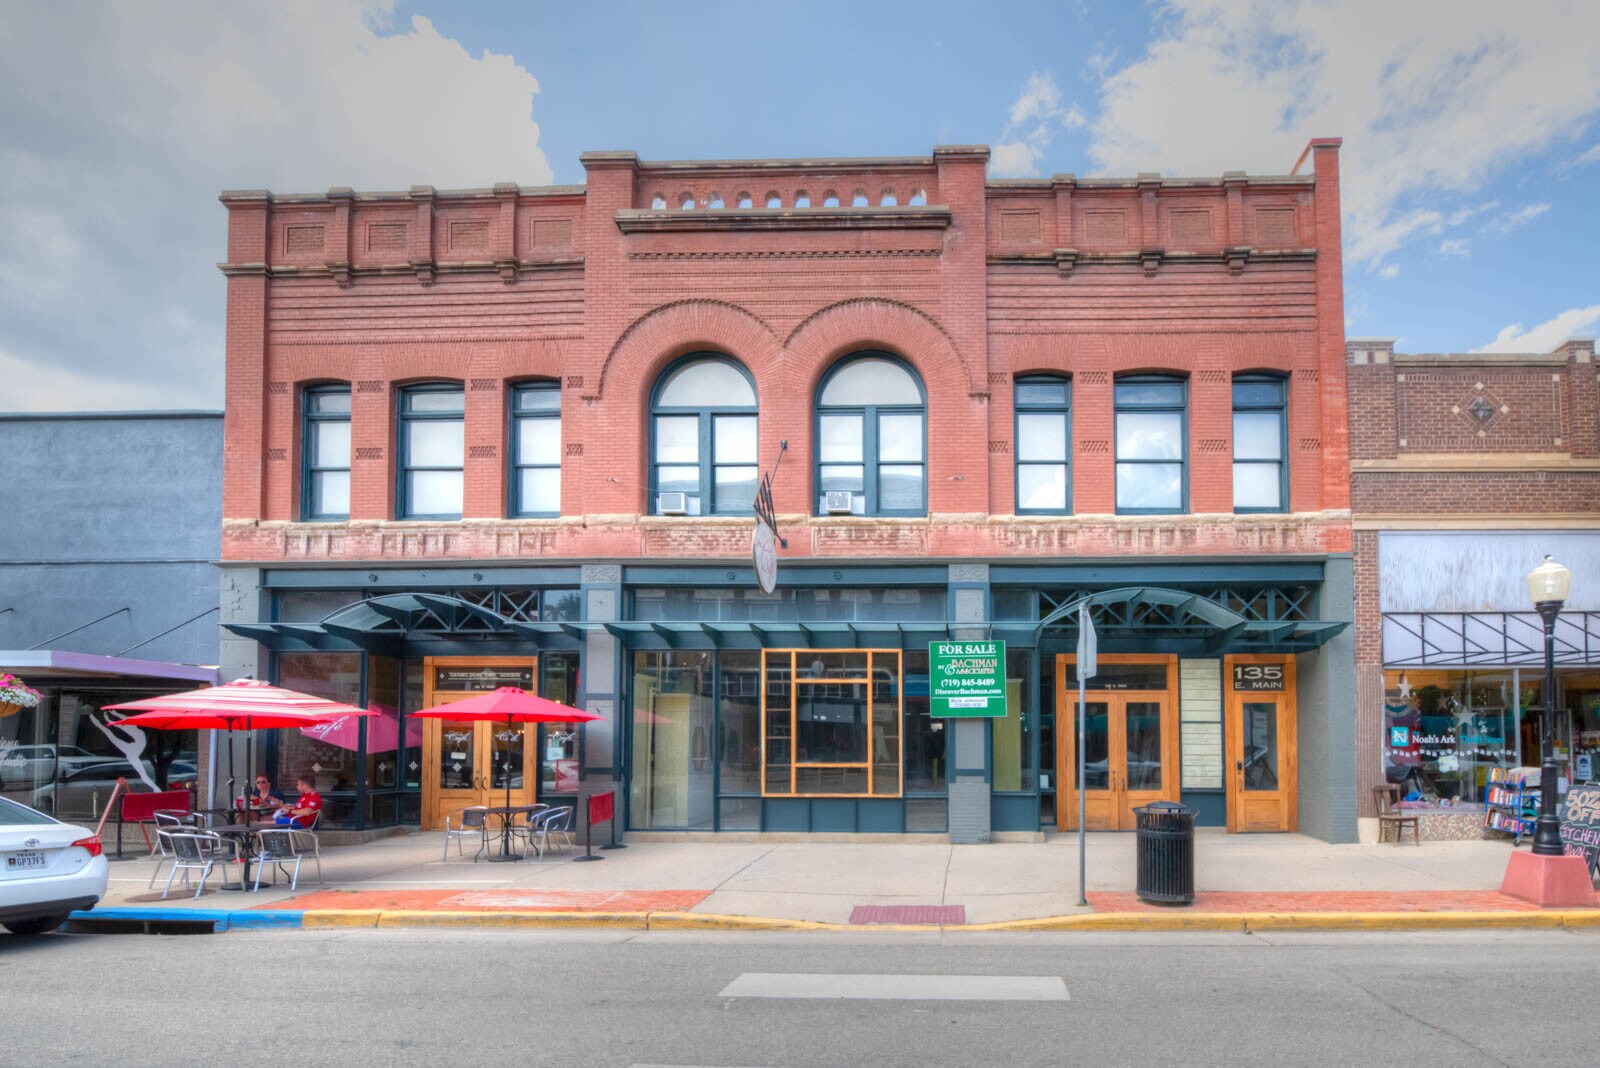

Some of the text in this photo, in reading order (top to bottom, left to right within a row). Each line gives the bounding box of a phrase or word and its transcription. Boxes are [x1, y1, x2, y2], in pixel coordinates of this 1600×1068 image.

[938, 644, 997, 655] FOR SALE
[951, 658, 998, 668] BACHMAN
[1234, 666, 1282, 680] 135
[940, 678, 996, 688] (719) 845-8489
[1234, 681, 1282, 689] E MAIN
[1412, 734, 1440, 744] Noah's
[1440, 734, 1456, 744] Ark
[1567, 805, 1600, 825] OFF
[1560, 823, 1600, 846] ITCHEN
